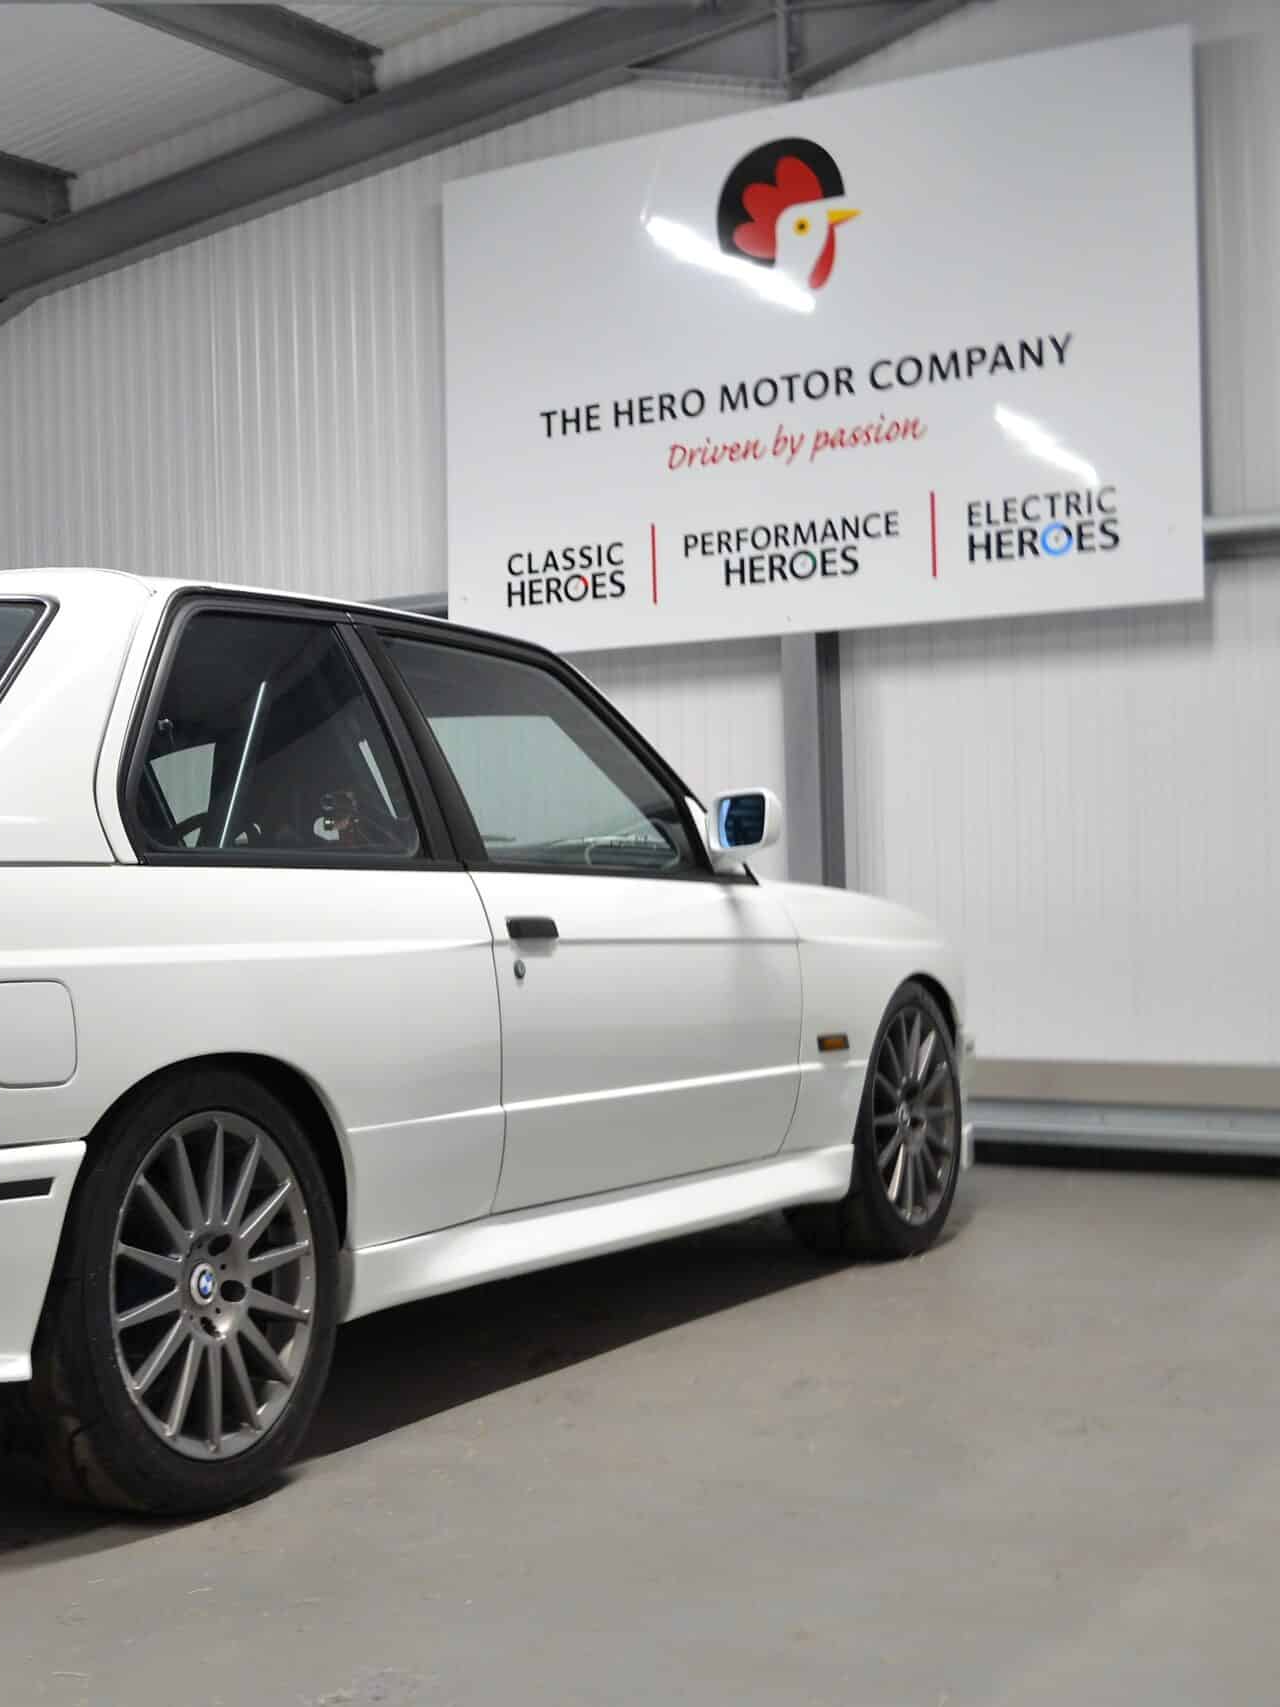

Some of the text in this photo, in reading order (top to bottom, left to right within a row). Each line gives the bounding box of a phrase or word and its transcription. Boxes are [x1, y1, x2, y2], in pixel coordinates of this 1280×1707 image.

[538, 333, 1073, 439] THE HERO MOTOR COMPANY
[667, 412, 928, 472] Driven by passion
[967, 486, 1117, 529] ELECTRIC
[683, 510, 900, 559] PERFORMANCE
[967, 517, 1121, 564] HEROES
[506, 541, 625, 577] CLASSIC
[723, 544, 860, 588] HEROES
[506, 569, 627, 609] HEROES
